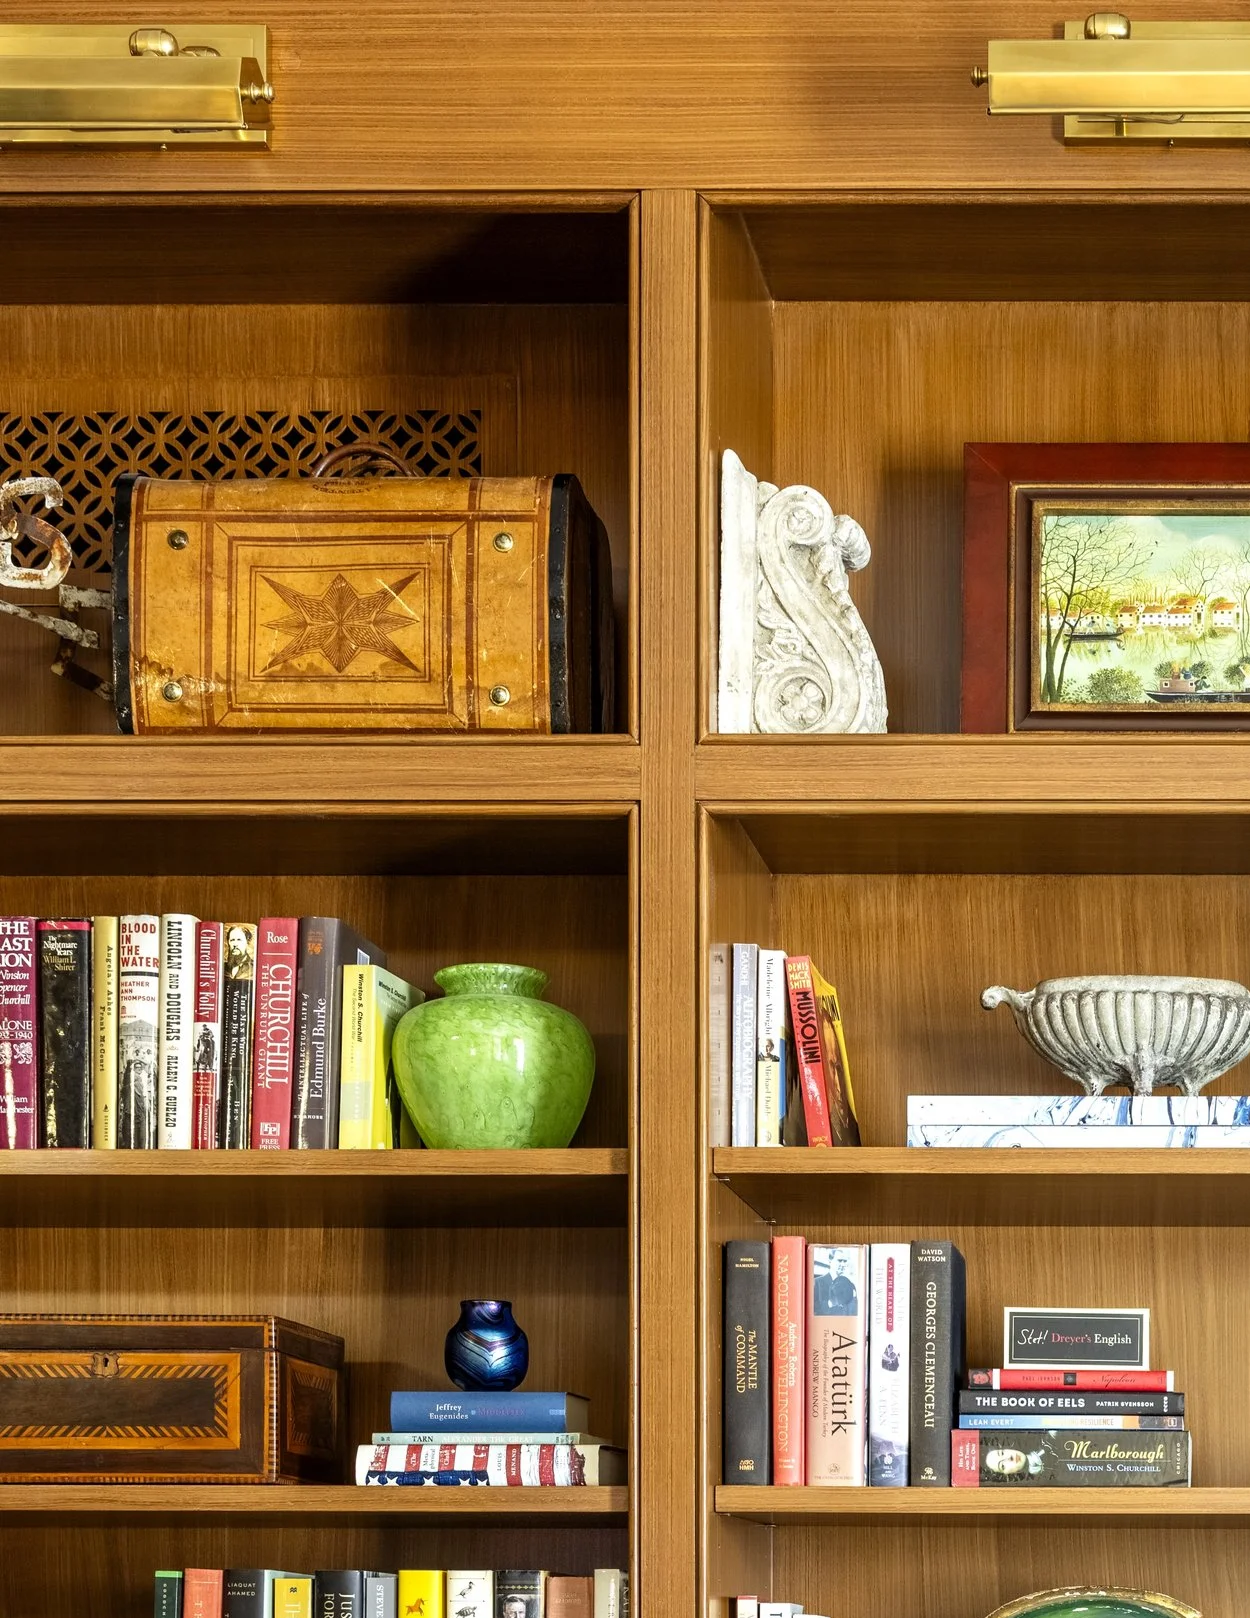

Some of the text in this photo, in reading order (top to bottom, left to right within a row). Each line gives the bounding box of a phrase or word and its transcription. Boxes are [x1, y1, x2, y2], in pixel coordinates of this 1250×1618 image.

[122, 923, 156, 934] BLOOD
[267, 931, 288, 944] Rose
[122, 934, 131, 945] IN
[121, 945, 140, 956] THE
[121, 957, 159, 968] WATER
[788, 962, 810, 972] DENIS
[166, 920, 182, 1041] LINCOLN AND DOUGLAS
[195, 929, 216, 1018] Churchill's Folly
[789, 971, 809, 981] MACK
[790, 980, 812, 990] SMITH
[765, 958, 774, 1036] Madeleine Albright
[265, 964, 293, 1089] CHURCHILL
[795, 990, 820, 1064] MUSSOLINI
[310, 998, 327, 1098] Edmund Burke
[789, 1322, 797, 1387] Andrew Roberts
[924, 1281, 936, 1428] GEORGES CLEMENCEAU
[831, 1331, 858, 1436] Atatürk
[436, 1404, 462, 1412] Jeffrey
[811, 1386, 819, 1418] MANGO
[976, 1397, 999, 1407] THE
[1001, 1397, 1037, 1408] BOOK
[1039, 1398, 1055, 1408] OF
[1057, 1398, 1085, 1408] EELS
[430, 1413, 469, 1421] Eugenides
[1063, 1440, 1164, 1460] Marlborough
[324, 1592, 334, 1618] FOR
